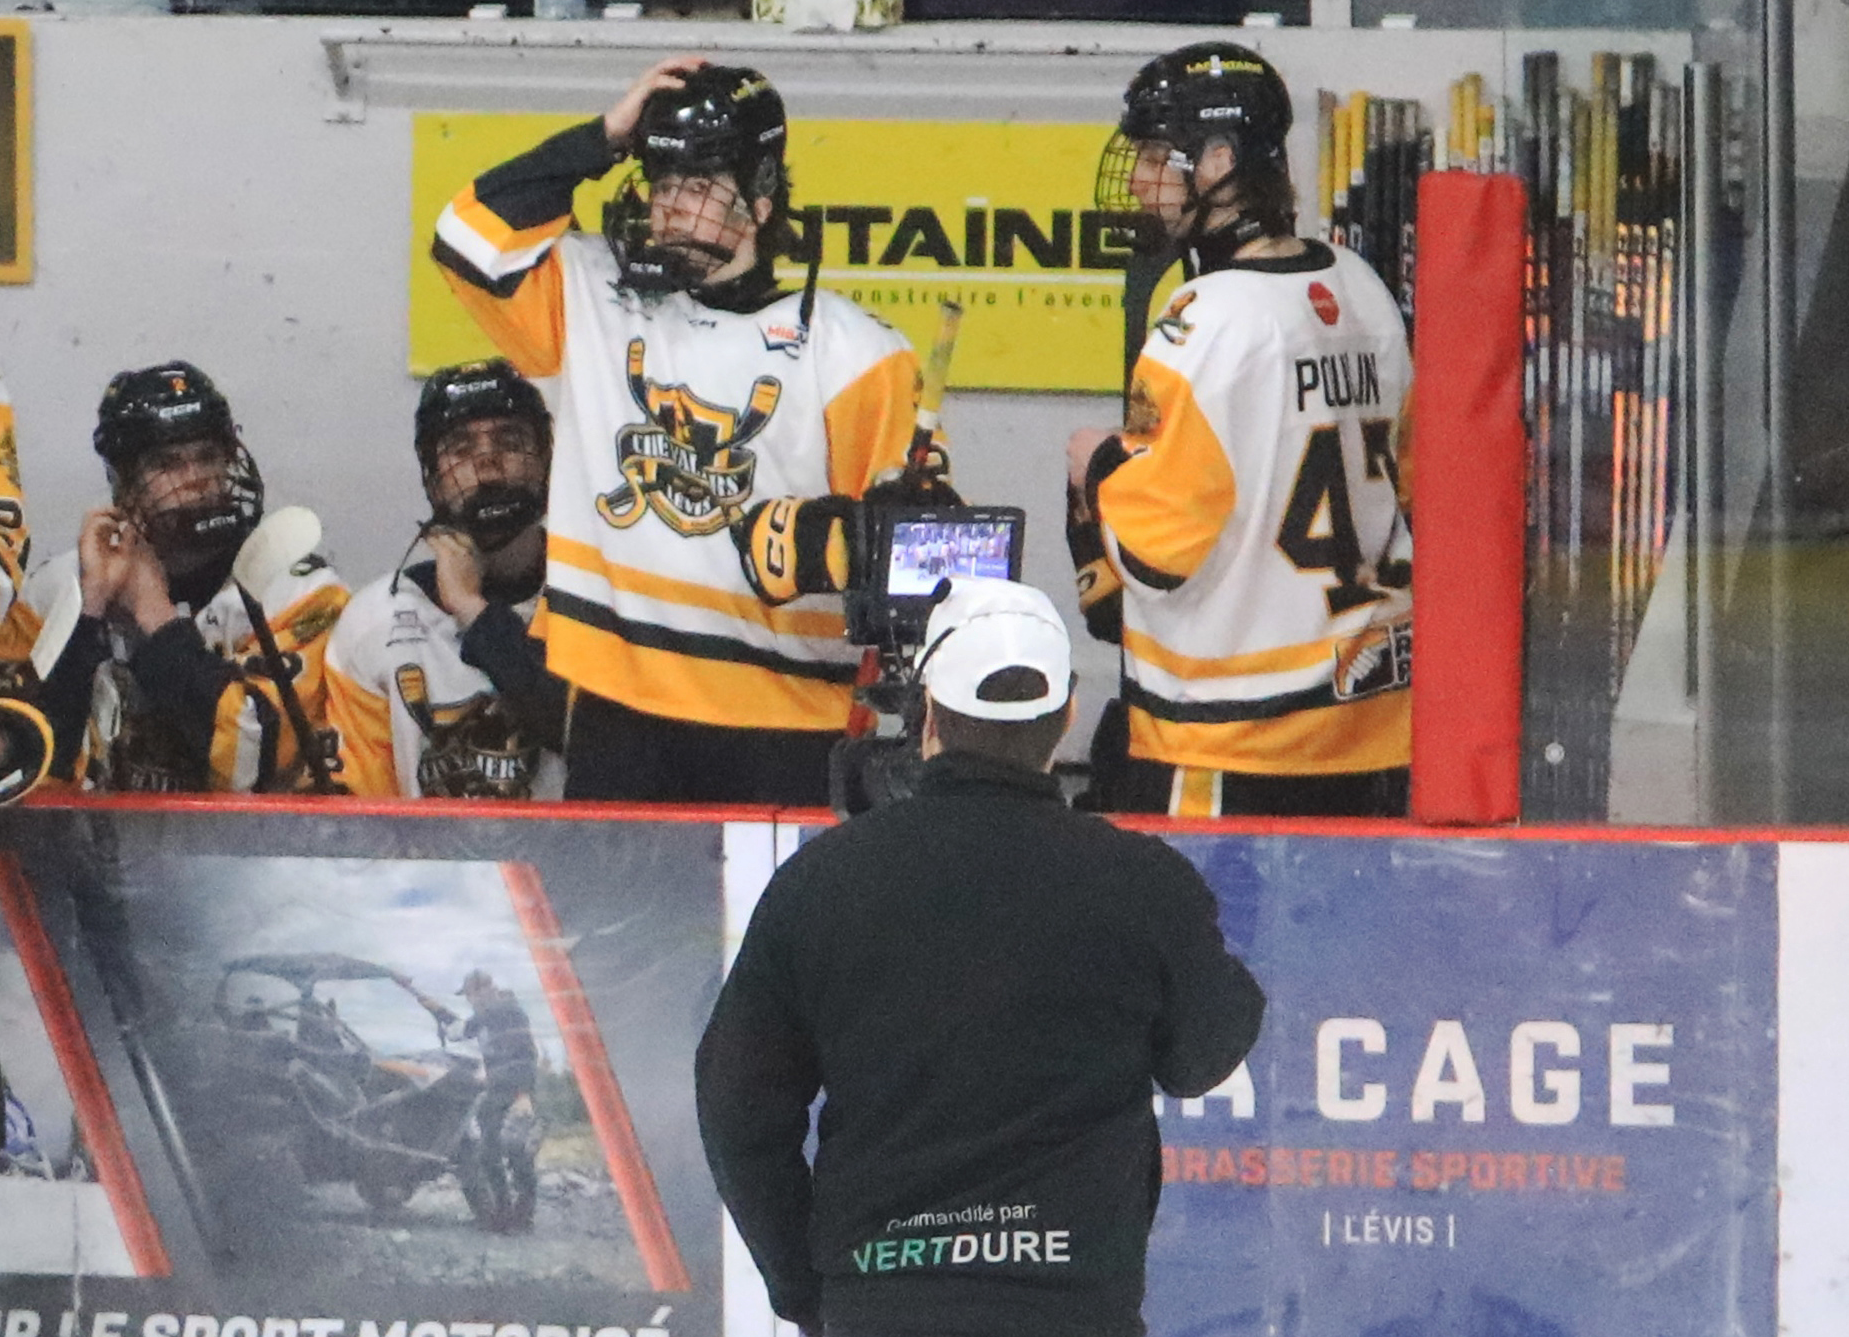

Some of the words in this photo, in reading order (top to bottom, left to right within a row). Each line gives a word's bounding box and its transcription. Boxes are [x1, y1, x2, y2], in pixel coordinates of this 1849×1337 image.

[1200, 106, 1243, 120] CCM
[1316, 1016, 1676, 1128] CAGE
[1160, 1145, 1398, 1189] BRASSERIE
[1410, 1149, 1628, 1193] SPORTIVE
[1344, 1207, 1436, 1247] LÉVIS
[852, 1229, 1072, 1275] VERTDURE
